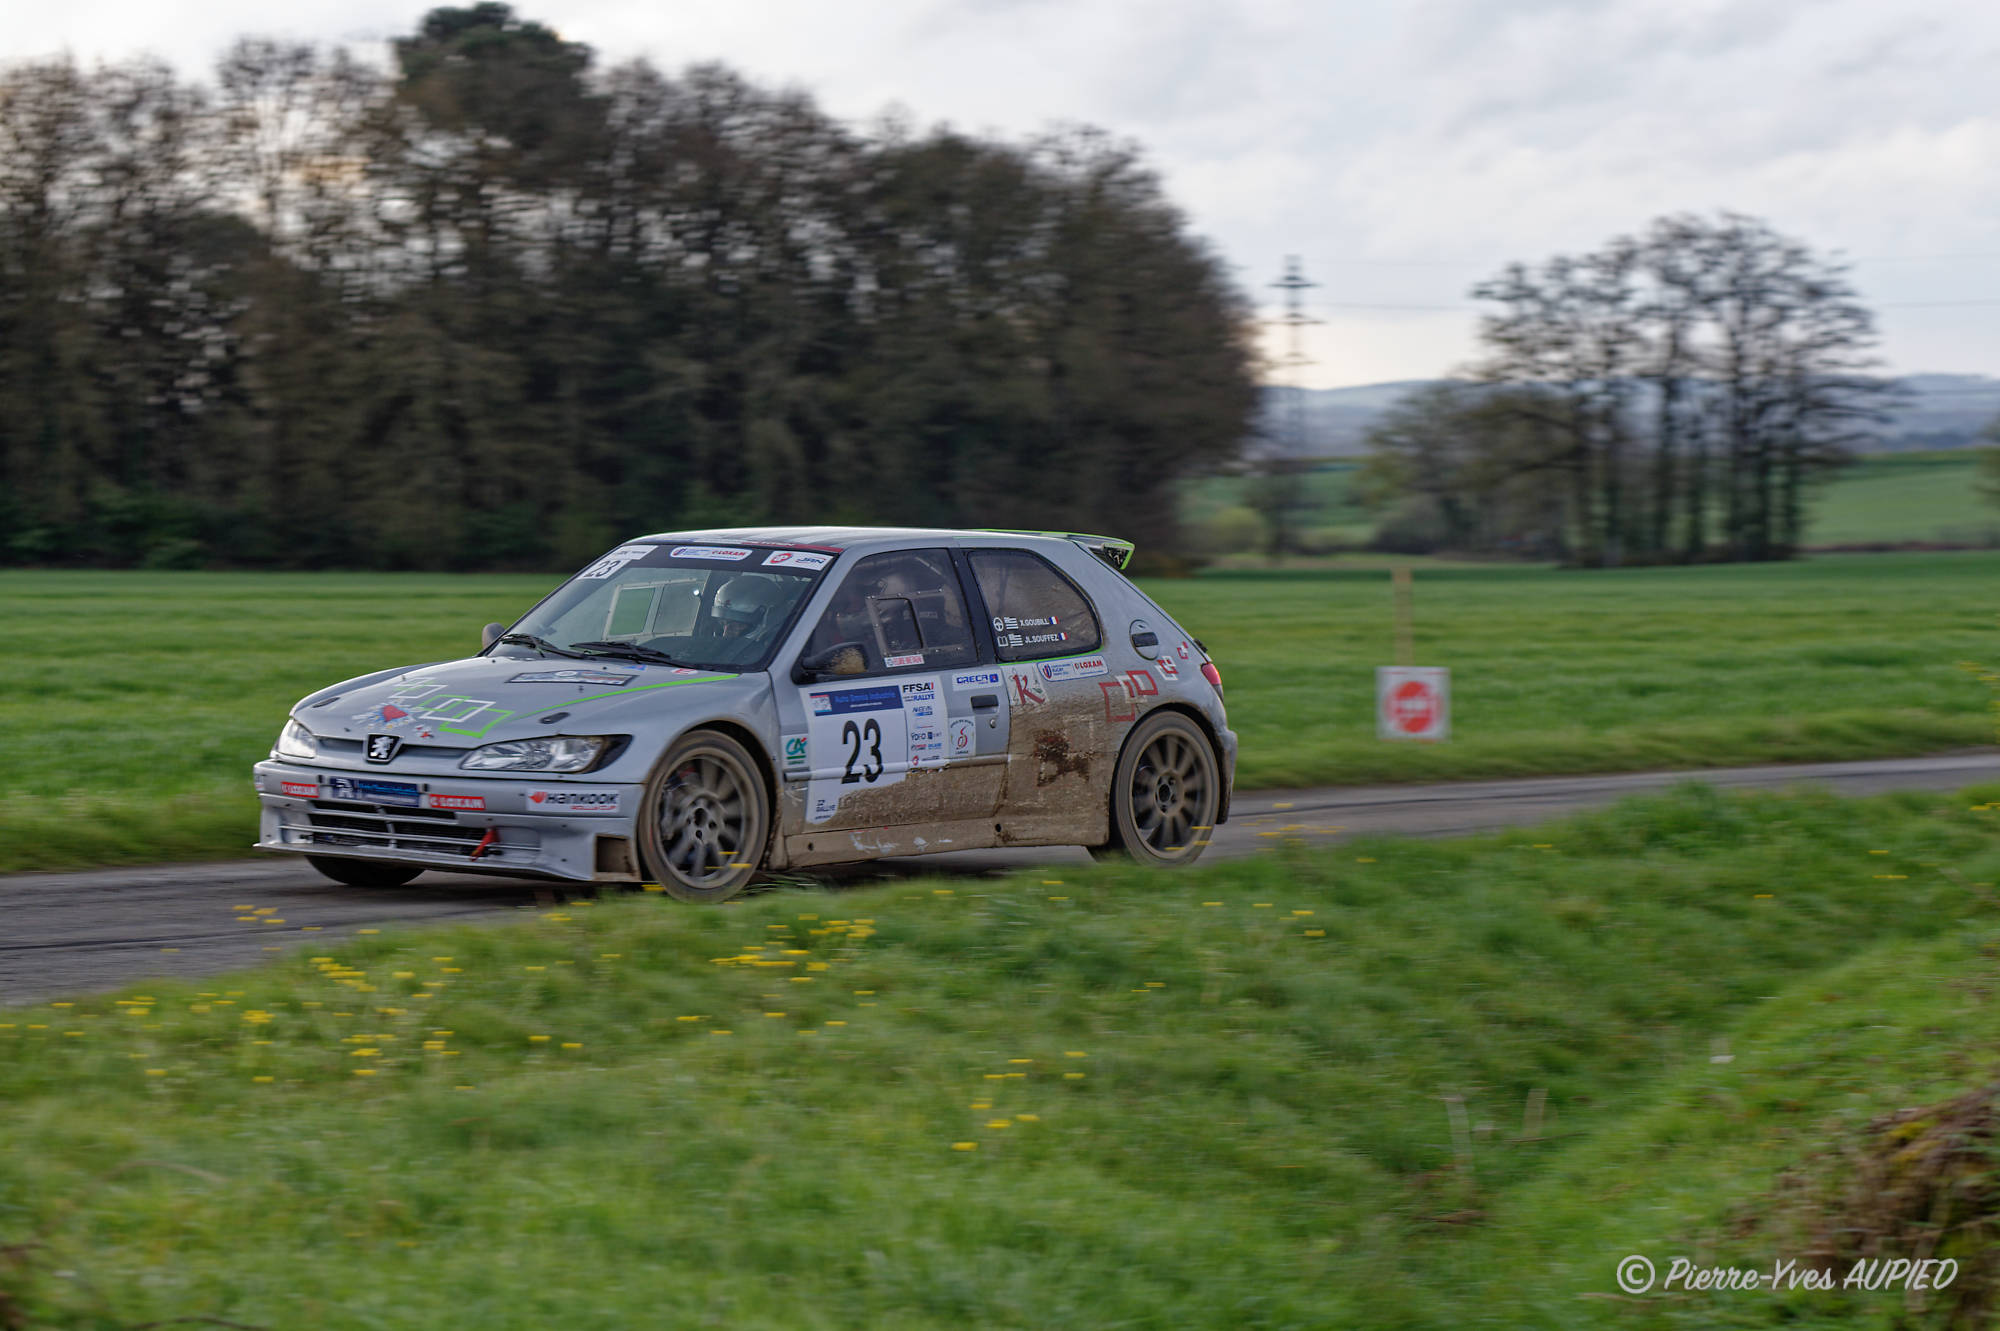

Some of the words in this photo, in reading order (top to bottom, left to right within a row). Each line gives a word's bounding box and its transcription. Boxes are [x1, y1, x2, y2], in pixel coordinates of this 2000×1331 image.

[583, 560, 621, 578] 23
[1080, 659, 1103, 670] LOXAM
[902, 682, 931, 694] FFSA
[841, 718, 884, 785] 23
